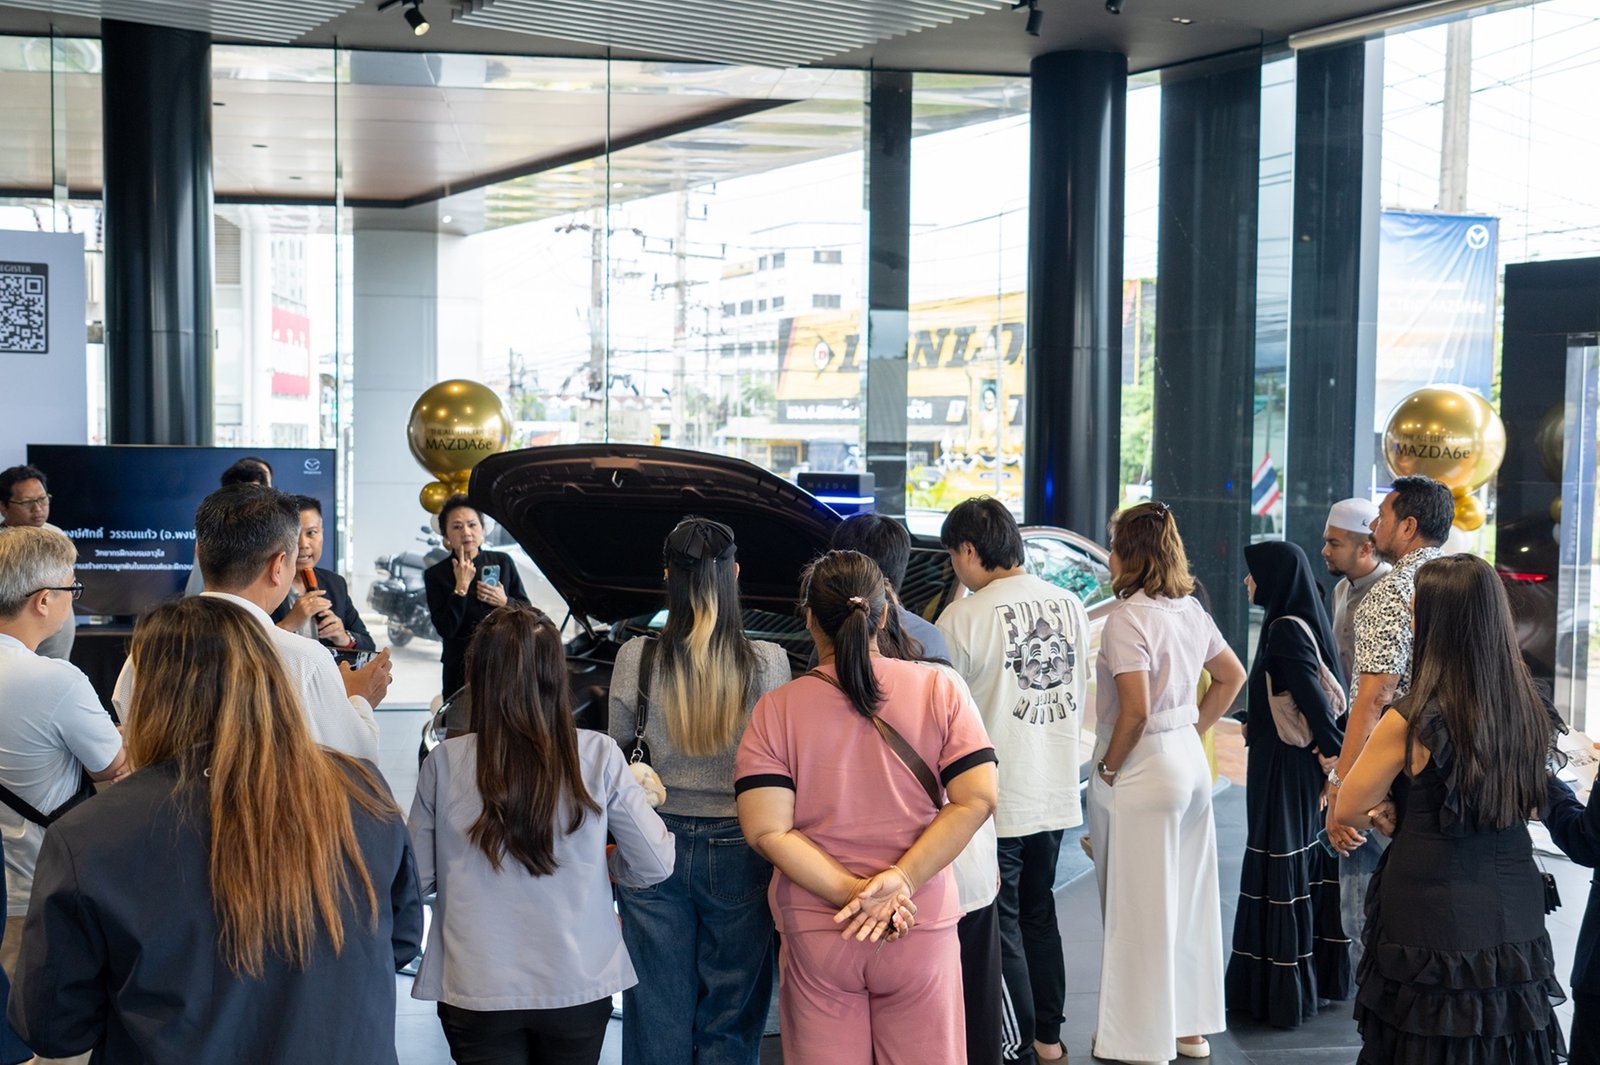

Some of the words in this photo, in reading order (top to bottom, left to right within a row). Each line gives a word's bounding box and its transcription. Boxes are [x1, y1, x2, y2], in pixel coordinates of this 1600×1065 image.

[426, 438, 493, 451] MAZDA6e
[1396, 443, 1471, 460] MAZDA6e
[807, 482, 847, 490] MAZDA
[995, 598, 1079, 659] EVISU
